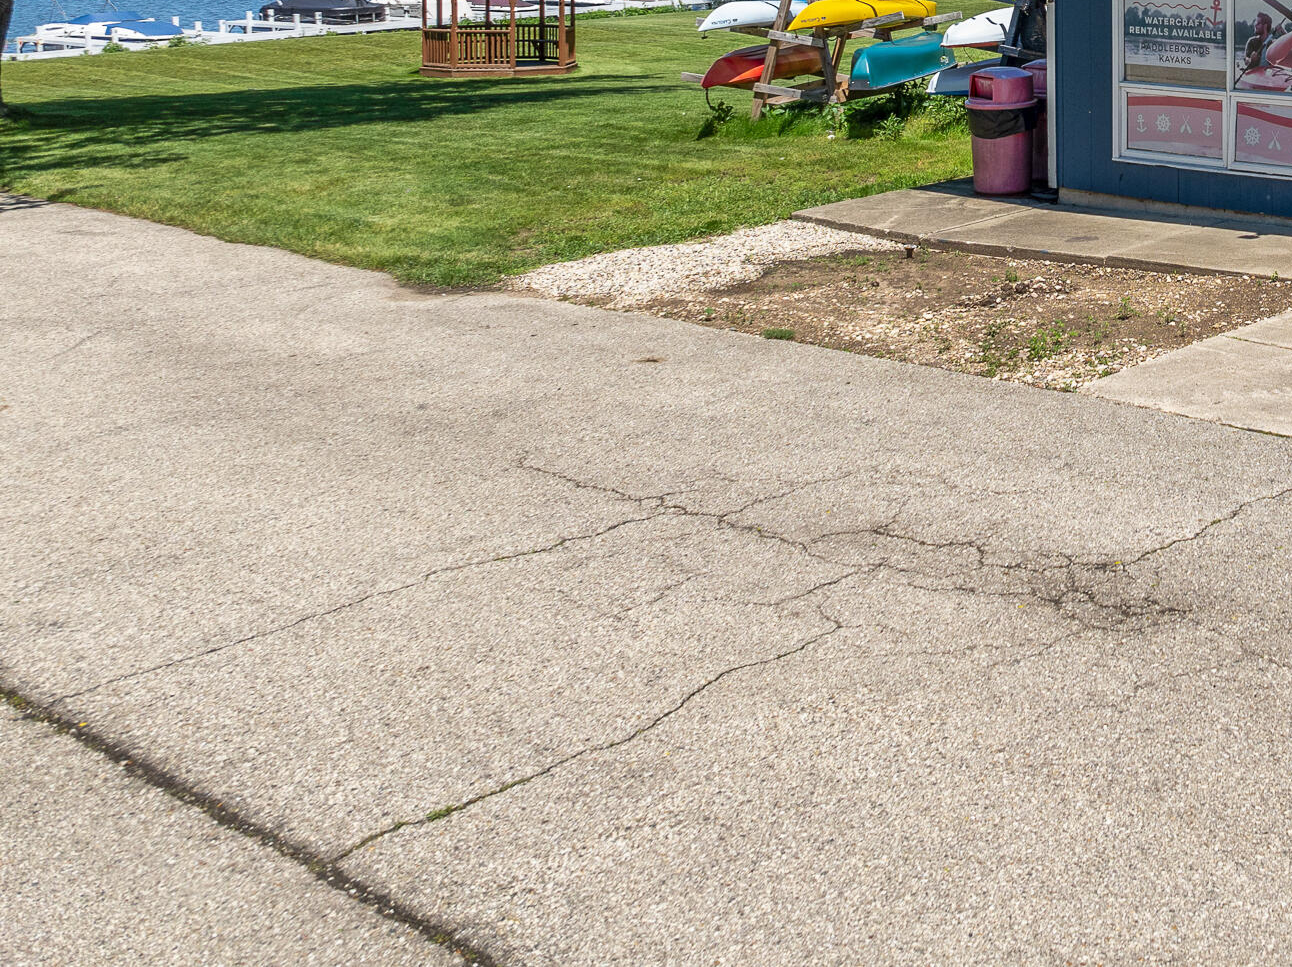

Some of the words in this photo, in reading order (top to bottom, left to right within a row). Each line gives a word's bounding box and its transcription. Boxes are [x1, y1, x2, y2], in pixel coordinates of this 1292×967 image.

[1144, 16, 1206, 28] WATERCRAFT
[1129, 26, 1169, 36] RENTALS
[1171, 28, 1222, 40] AVAILABLE
[1140, 43, 1210, 55] PADDLEBOARDS
[1159, 54, 1192, 65] KAYAKS
